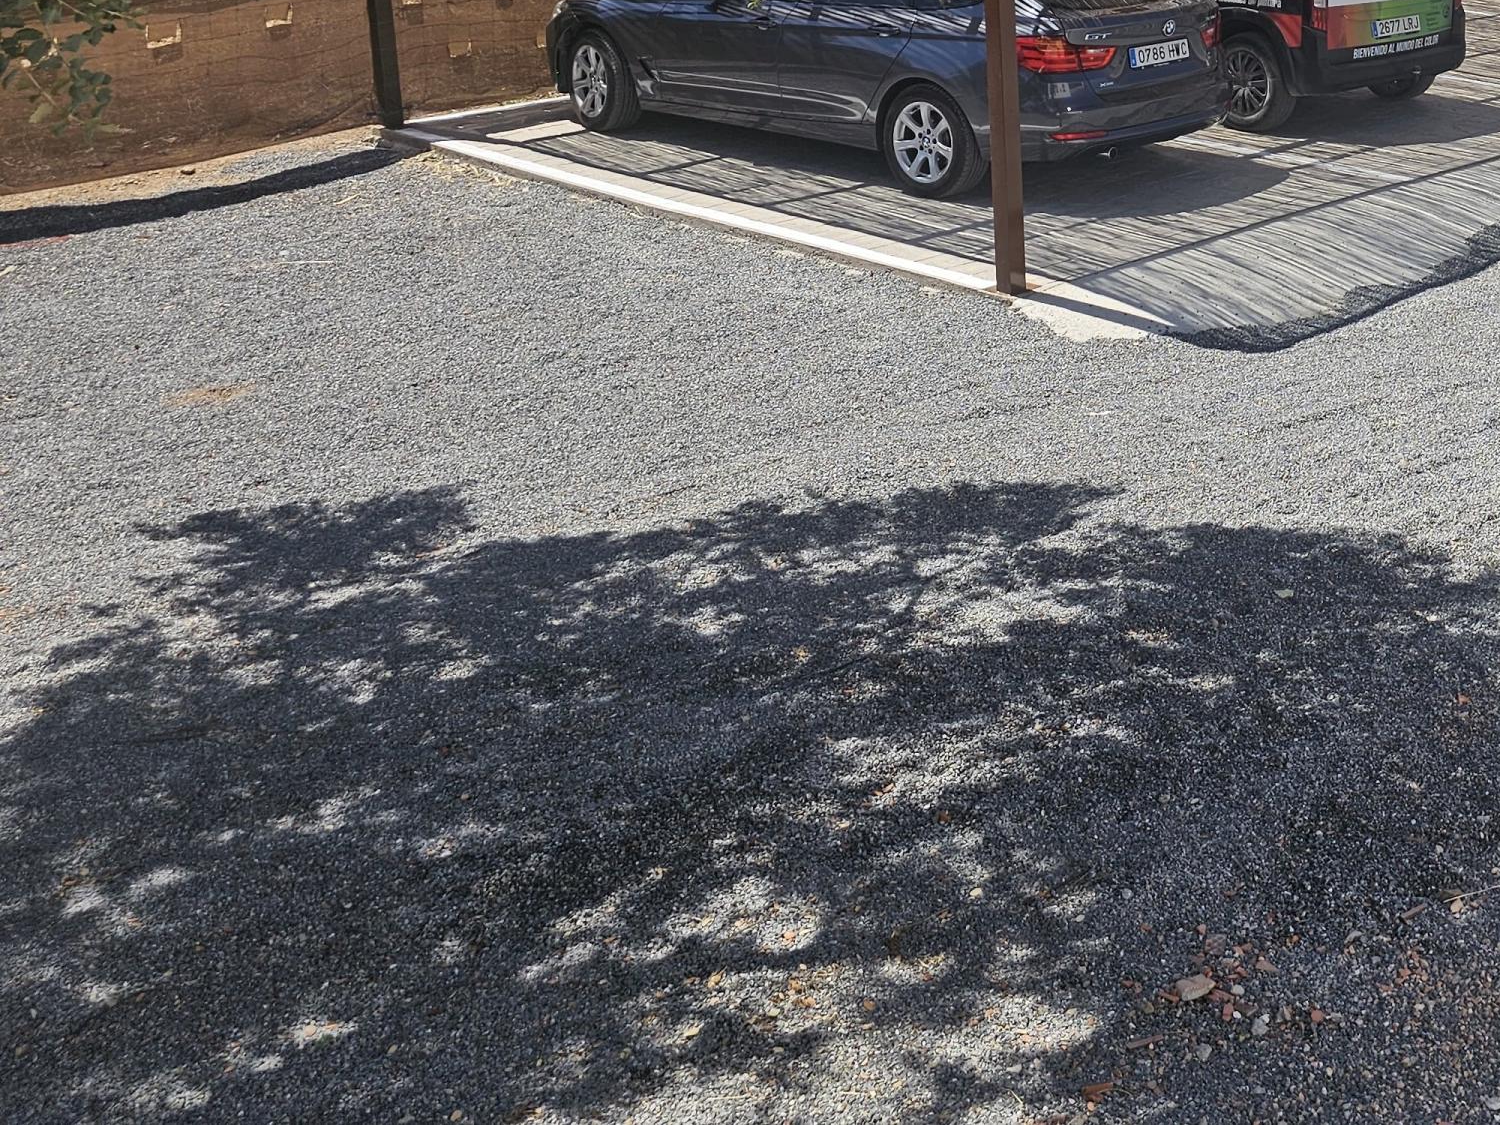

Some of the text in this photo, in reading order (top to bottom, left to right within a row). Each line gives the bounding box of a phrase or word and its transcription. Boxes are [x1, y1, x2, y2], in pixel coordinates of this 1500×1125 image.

[1378, 16, 1419, 35] 2677 LRJ
[1138, 46, 1166, 64] 0786
[1353, 34, 1440, 59] BIENVENIDO AL MUNDO DEL COLOR
